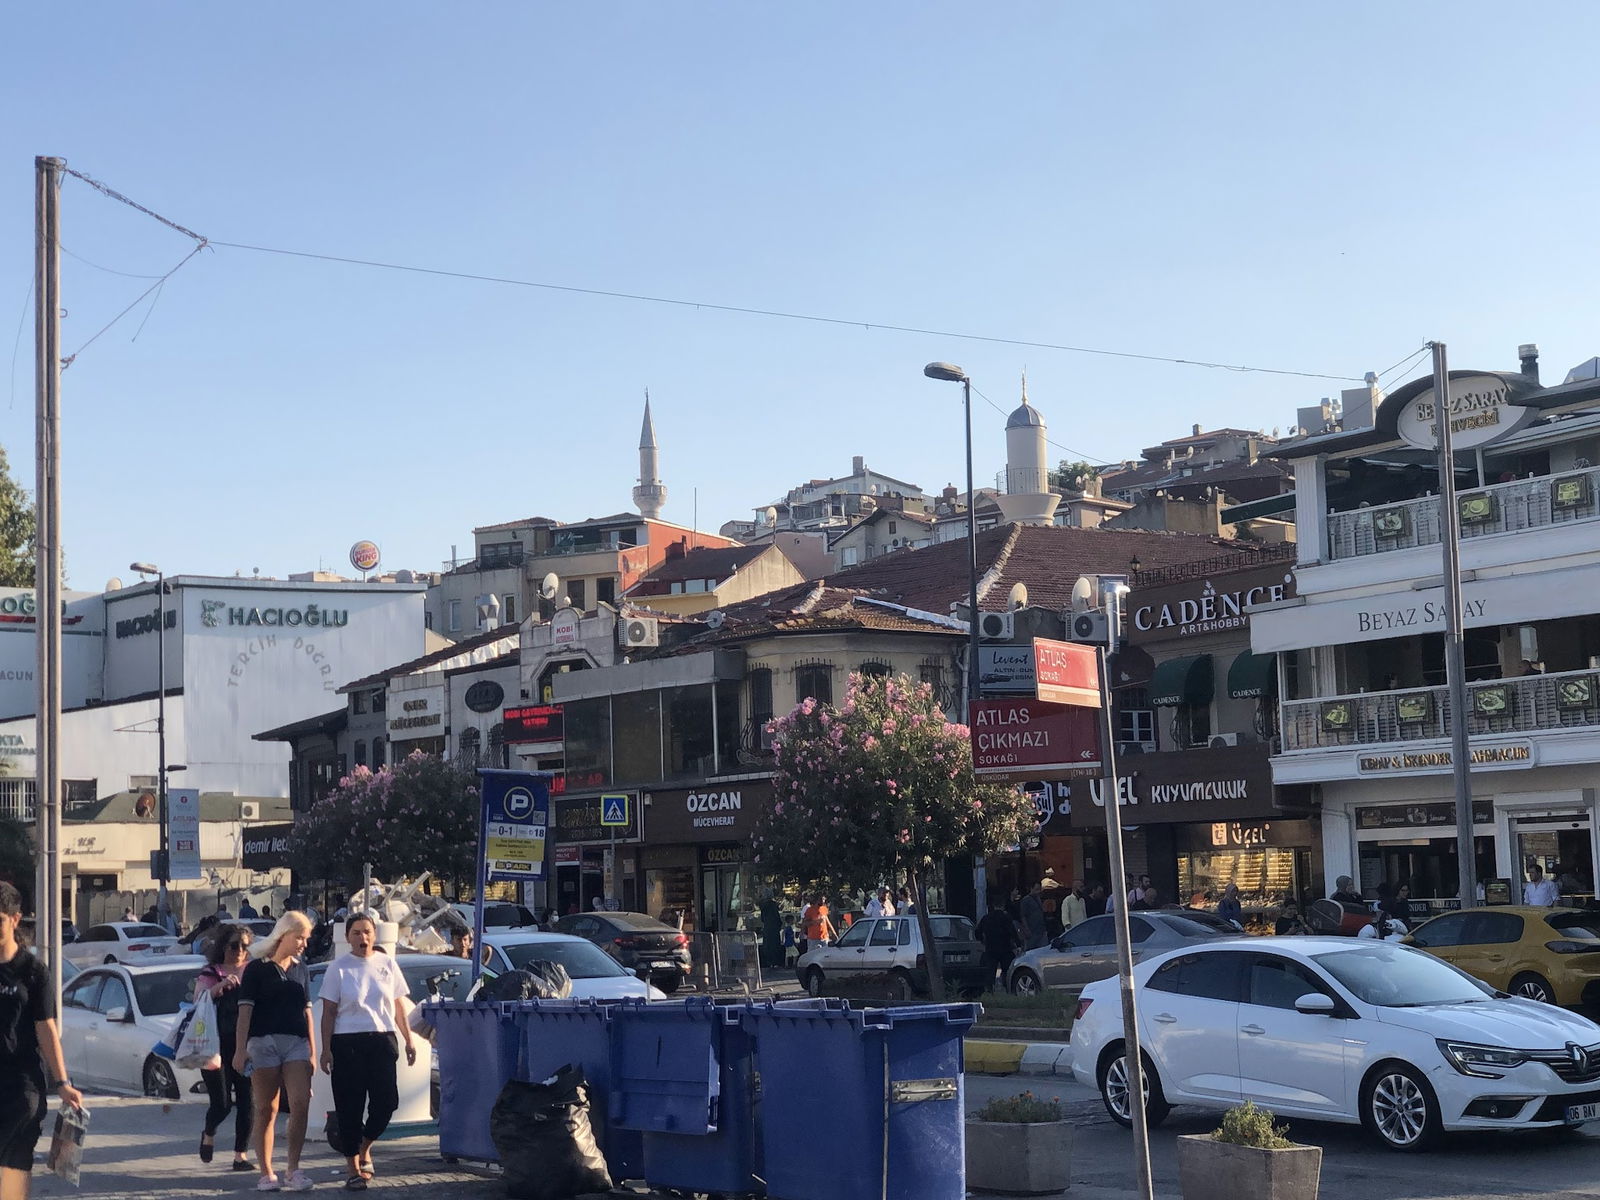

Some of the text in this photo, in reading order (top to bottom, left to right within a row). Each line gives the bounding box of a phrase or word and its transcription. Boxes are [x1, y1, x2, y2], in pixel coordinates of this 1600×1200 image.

[1416, 398, 1461, 421] BEZ
[228, 604, 348, 628] HACIOĞLU
[1134, 584, 1285, 631] CADENCE
[1358, 599, 1487, 632] BEYAZ SAAY
[1180, 616, 1247, 635] ART&HOBBY
[993, 651, 1028, 664] Levent
[1040, 649, 1067, 668] ATLAS
[1153, 695, 1182, 705] CADENCE
[1232, 688, 1262, 698] CADENCE
[976, 708, 1030, 726] ATLAS
[978, 731, 1049, 753] ÇIKMAZI
[979, 753, 1018, 765] SOKAĞI
[1470, 747, 1529, 763] AHMACUN
[1151, 779, 1248, 803] KUYUMCULUK
[686, 790, 742, 812] ÖZCAN
[693, 816, 735, 827] MÜCEVHERAT
[1232, 823, 1266, 849] ÜÇEL
[244, 838, 270, 854] demir
[1570, 1107, 1580, 1120] 06
